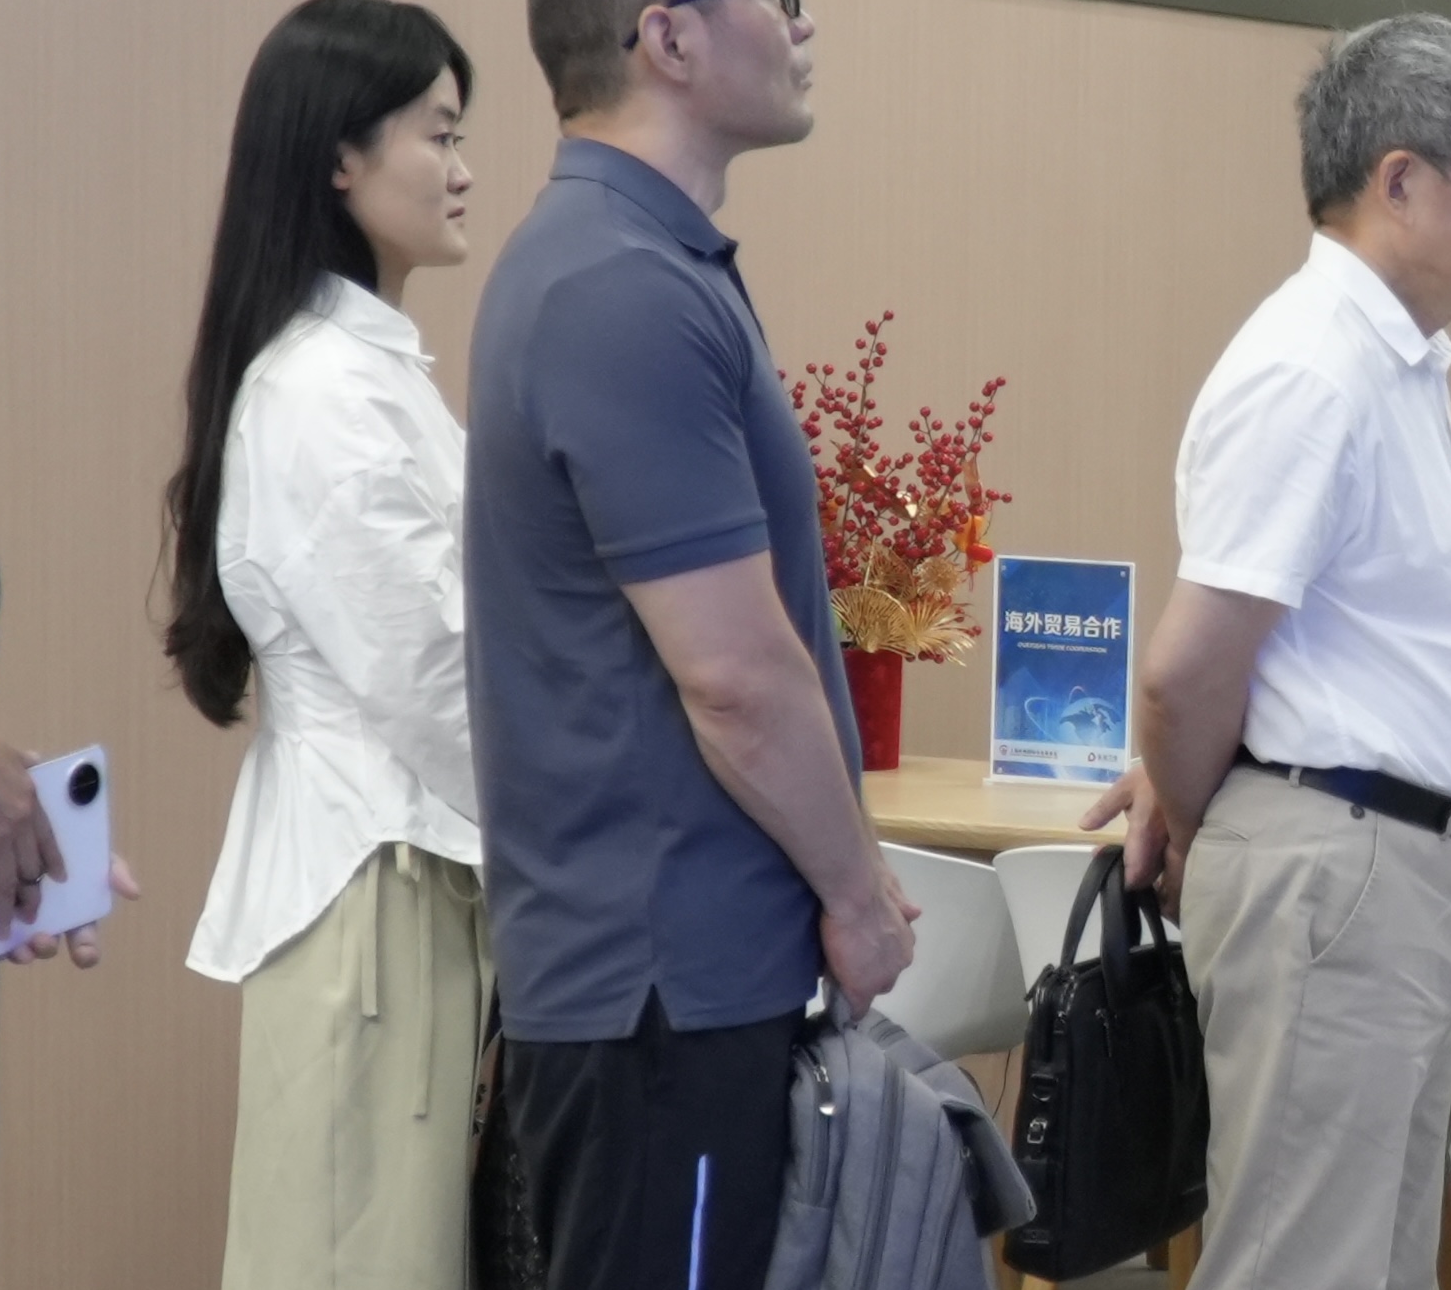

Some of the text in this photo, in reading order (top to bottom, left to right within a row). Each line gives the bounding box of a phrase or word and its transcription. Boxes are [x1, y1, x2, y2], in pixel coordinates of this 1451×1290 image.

[1004, 610, 1122, 640] 海外贸易合作
